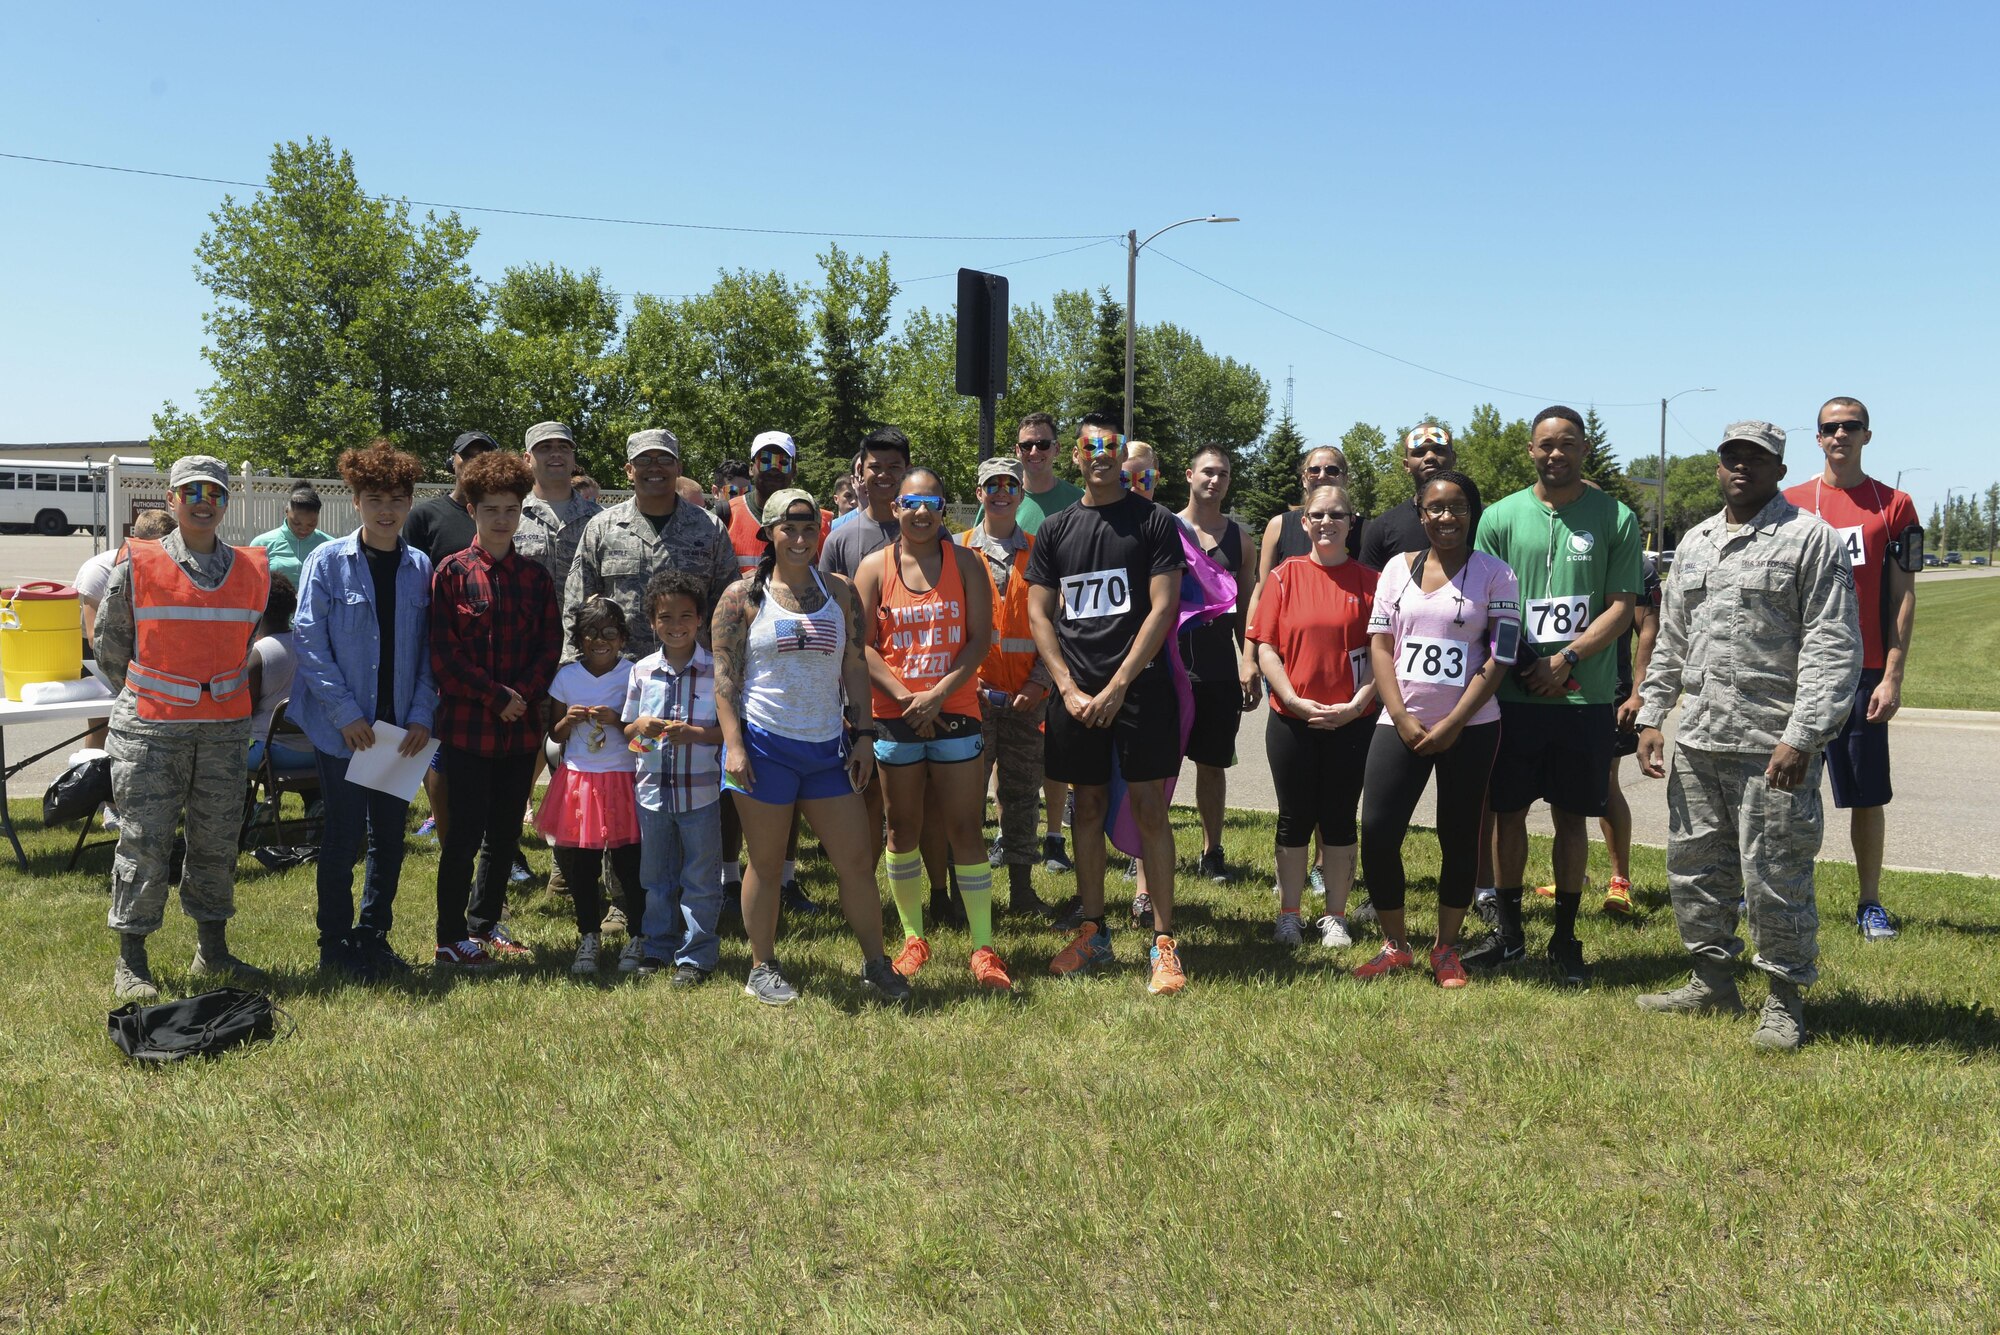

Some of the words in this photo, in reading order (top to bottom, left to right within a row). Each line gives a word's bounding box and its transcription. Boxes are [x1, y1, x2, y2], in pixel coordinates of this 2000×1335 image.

[1067, 575, 1126, 612] 770
[891, 600, 960, 626] THERE'S
[1532, 602, 1589, 636] 782
[892, 630, 913, 650] NO
[918, 627, 943, 647] WE
[948, 625, 961, 643] IN
[1405, 642, 1464, 679] 783
